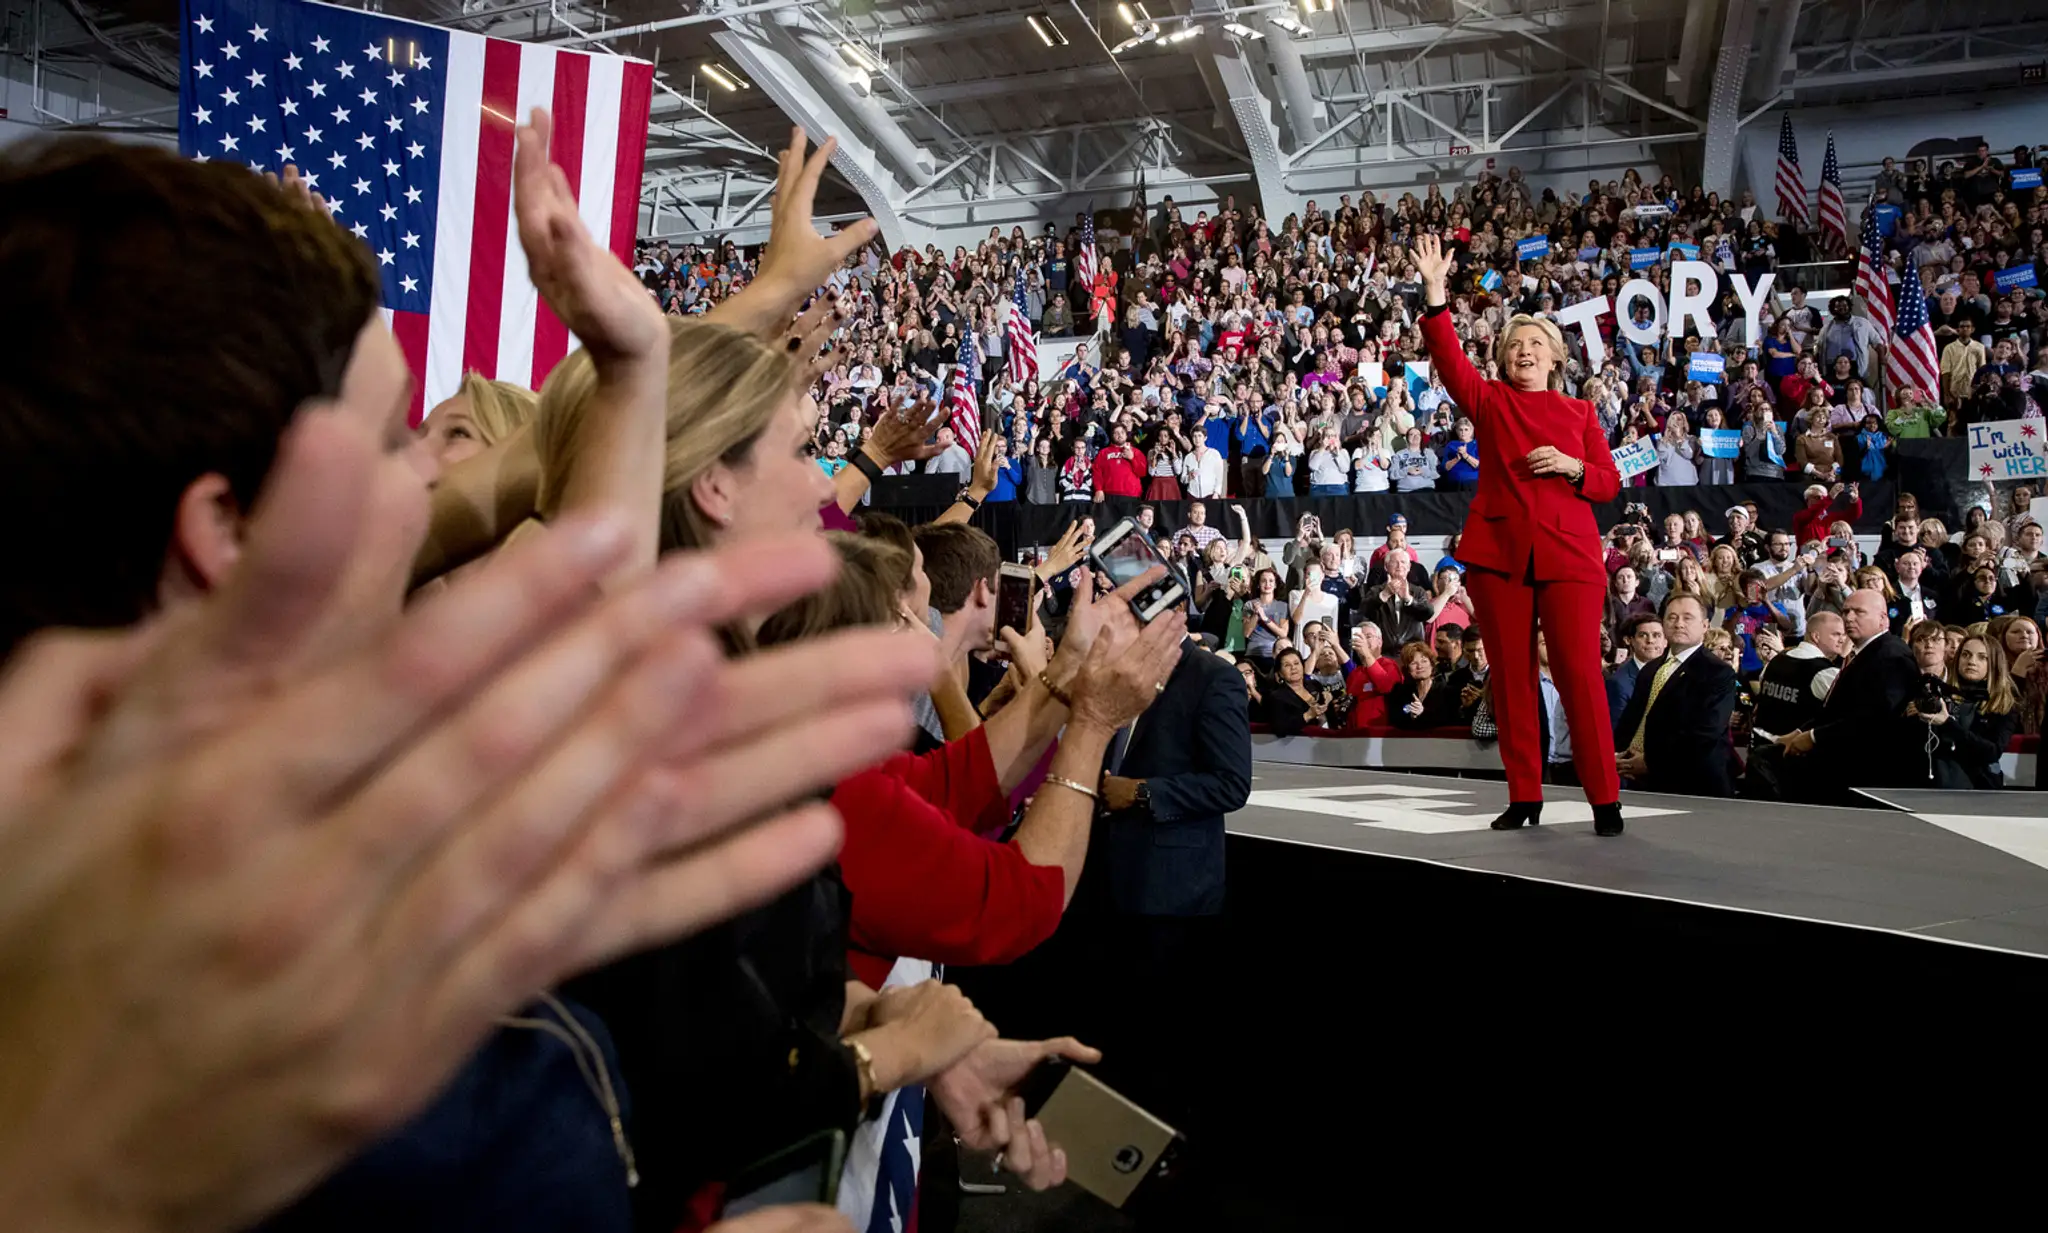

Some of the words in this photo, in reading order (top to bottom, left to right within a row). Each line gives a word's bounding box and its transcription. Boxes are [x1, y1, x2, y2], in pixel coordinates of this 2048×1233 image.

[1452, 147, 1468, 156] 210
[1560, 260, 1776, 375] TORY
[1970, 426, 2006, 449] I'm
[1993, 441, 2034, 459] with
[2006, 456, 2047, 476] HER
[1762, 681, 1800, 703] POLICE
